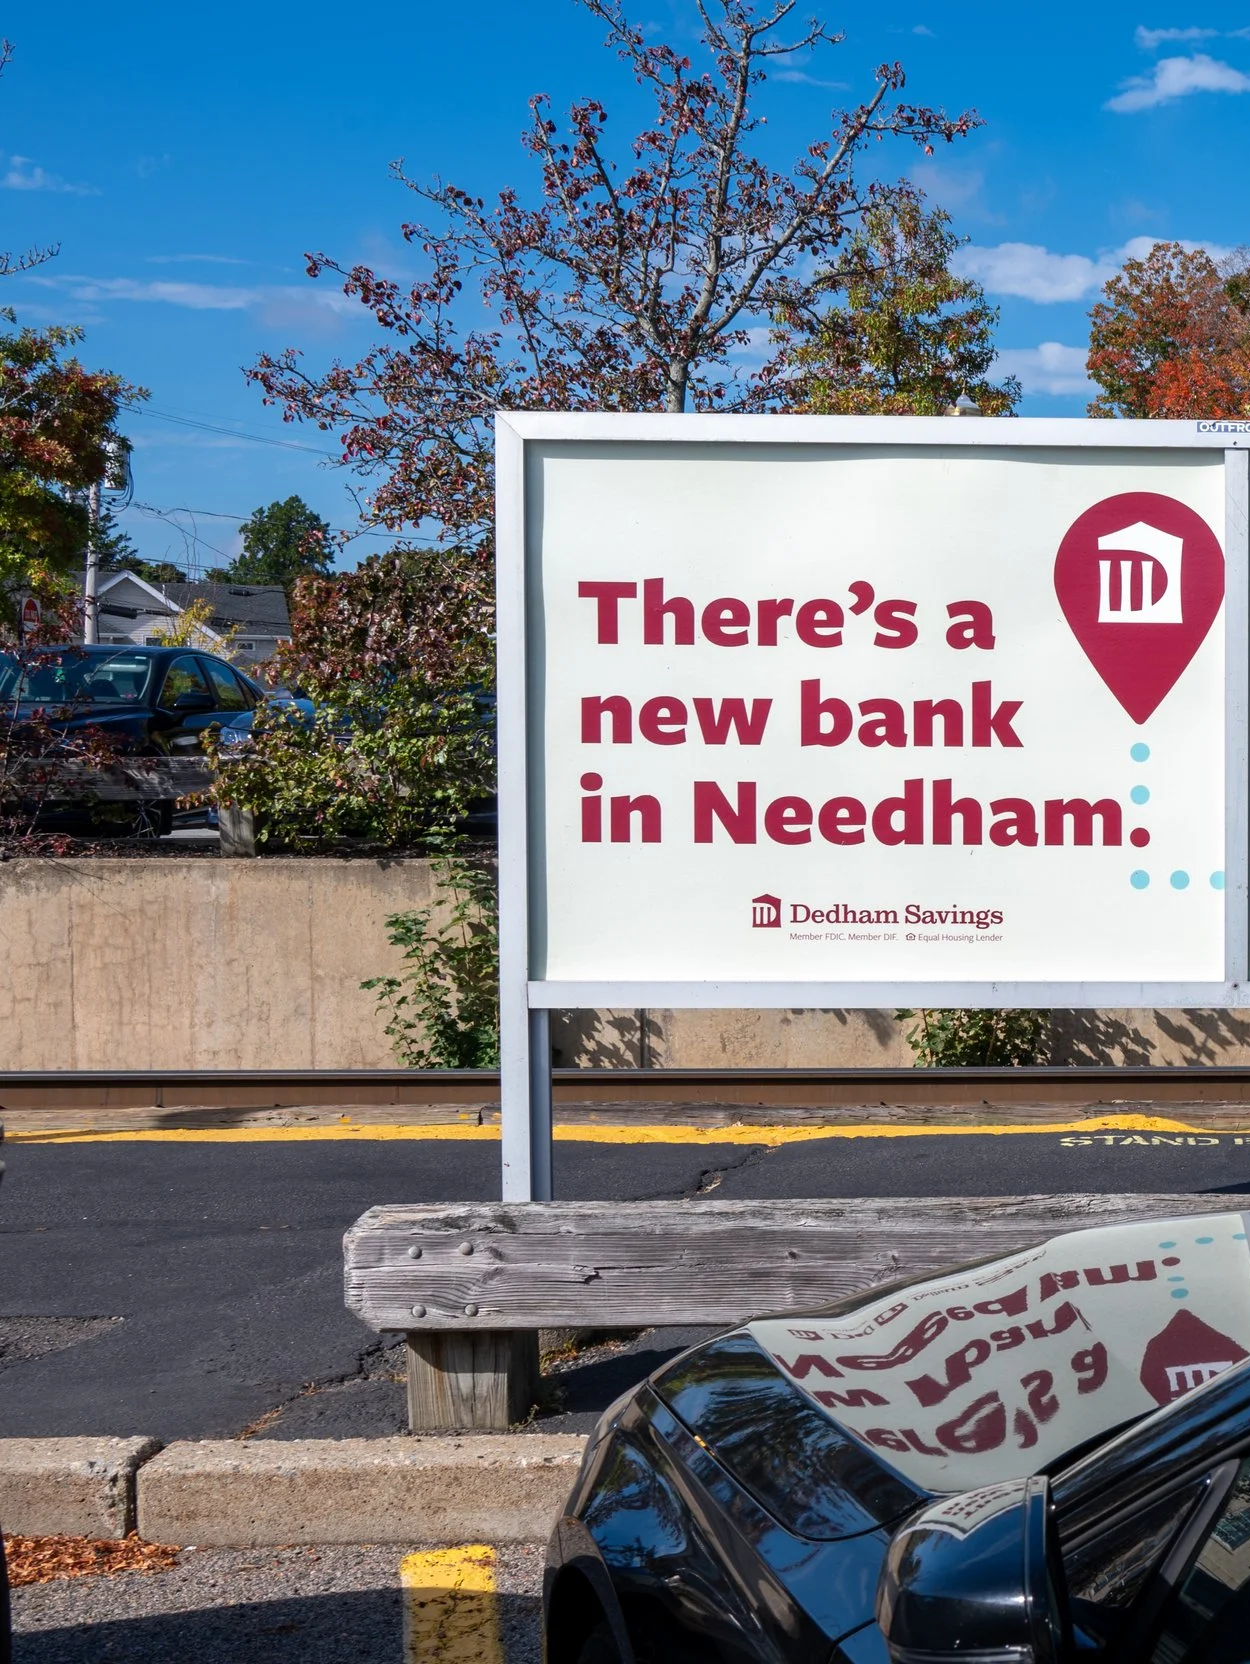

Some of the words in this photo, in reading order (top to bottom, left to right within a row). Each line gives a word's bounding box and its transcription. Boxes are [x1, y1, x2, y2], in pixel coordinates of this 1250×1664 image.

[578, 578, 918, 649] There's
[946, 601, 996, 650] a
[581, 696, 771, 746] new
[801, 679, 1023, 748] bank
[580, 773, 661, 844] in
[694, 779, 1150, 847] Needham.
[790, 903, 898, 924] Dedham
[904, 904, 1004, 929] Savings
[789, 933, 824, 941] Member
[825, 933, 846, 941] FDIC.
[848, 933, 882, 941] Member
[918, 933, 940, 943] Equal
[942, 933, 975, 943] Housing
[976, 933, 1004, 942] Lender
[1059, 1135, 1220, 1147] STAND
